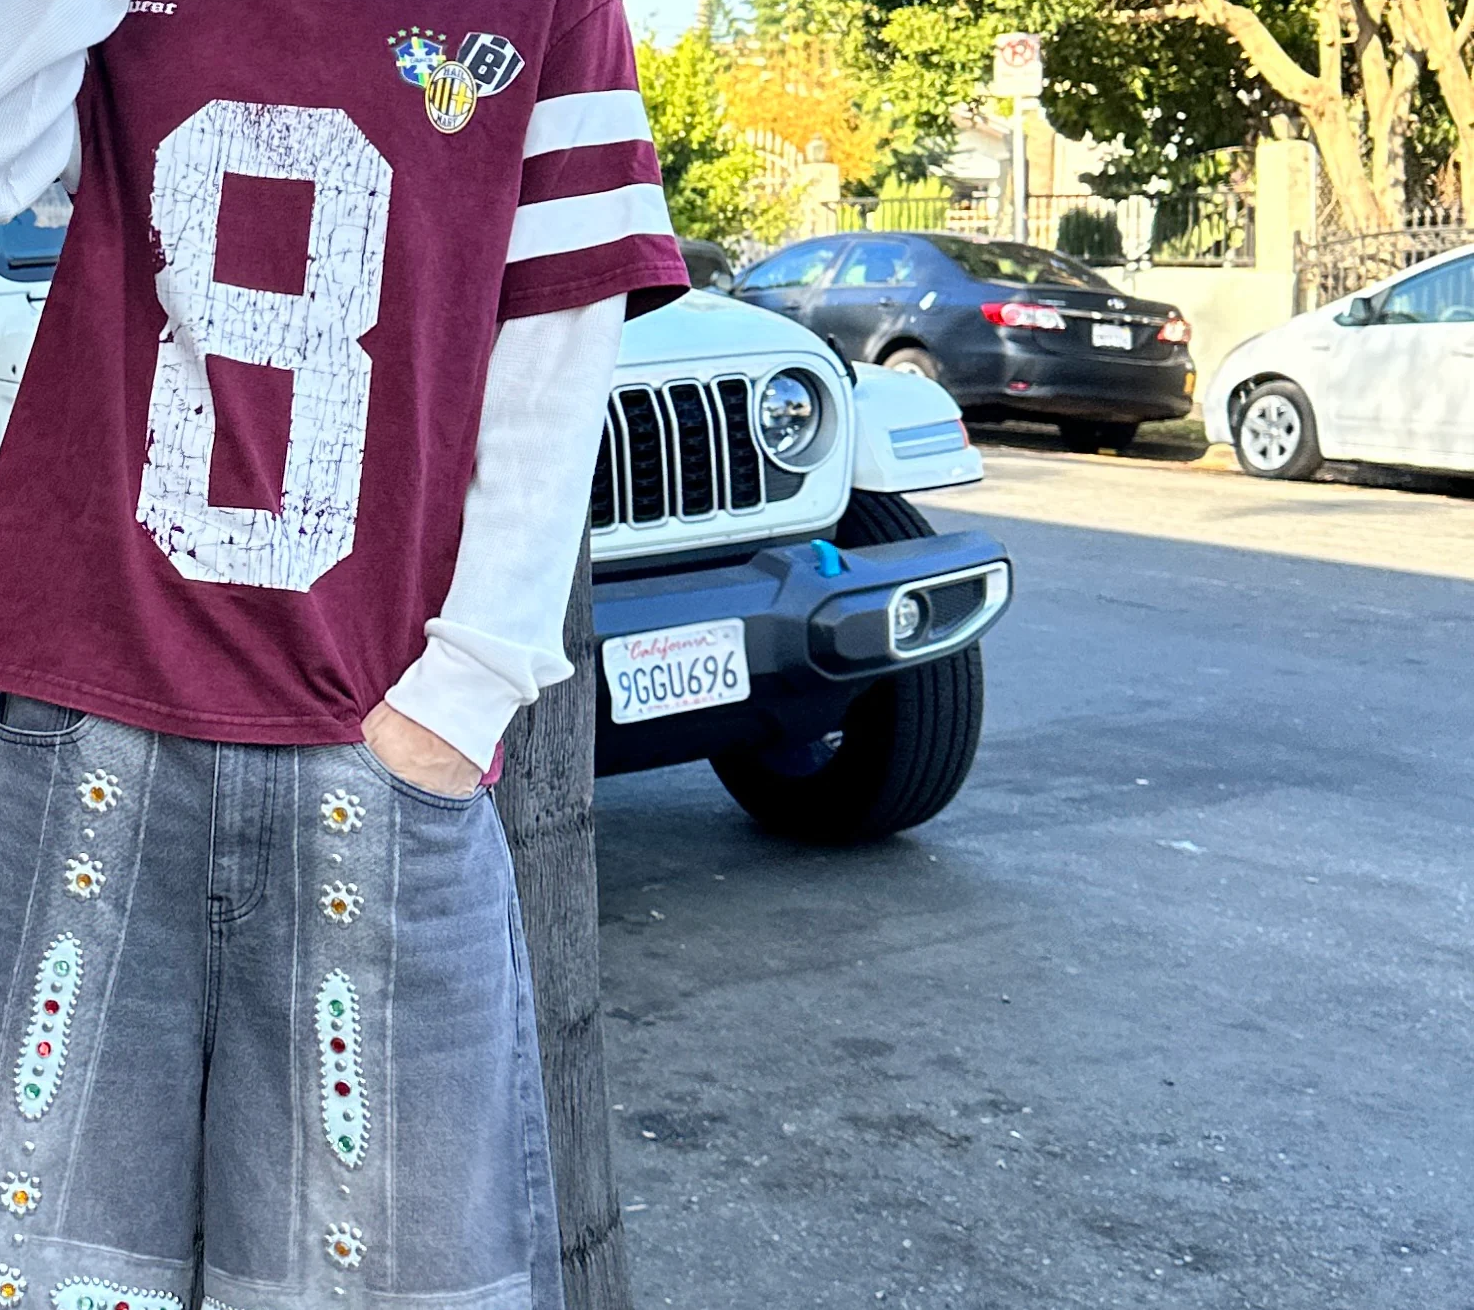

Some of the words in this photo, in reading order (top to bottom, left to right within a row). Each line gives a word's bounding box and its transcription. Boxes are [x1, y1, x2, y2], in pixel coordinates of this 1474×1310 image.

[443, 66, 466, 81] HAIL
[136, 98, 394, 593] 8
[629, 635, 710, 660] California
[618, 650, 739, 711] 9GGU696
